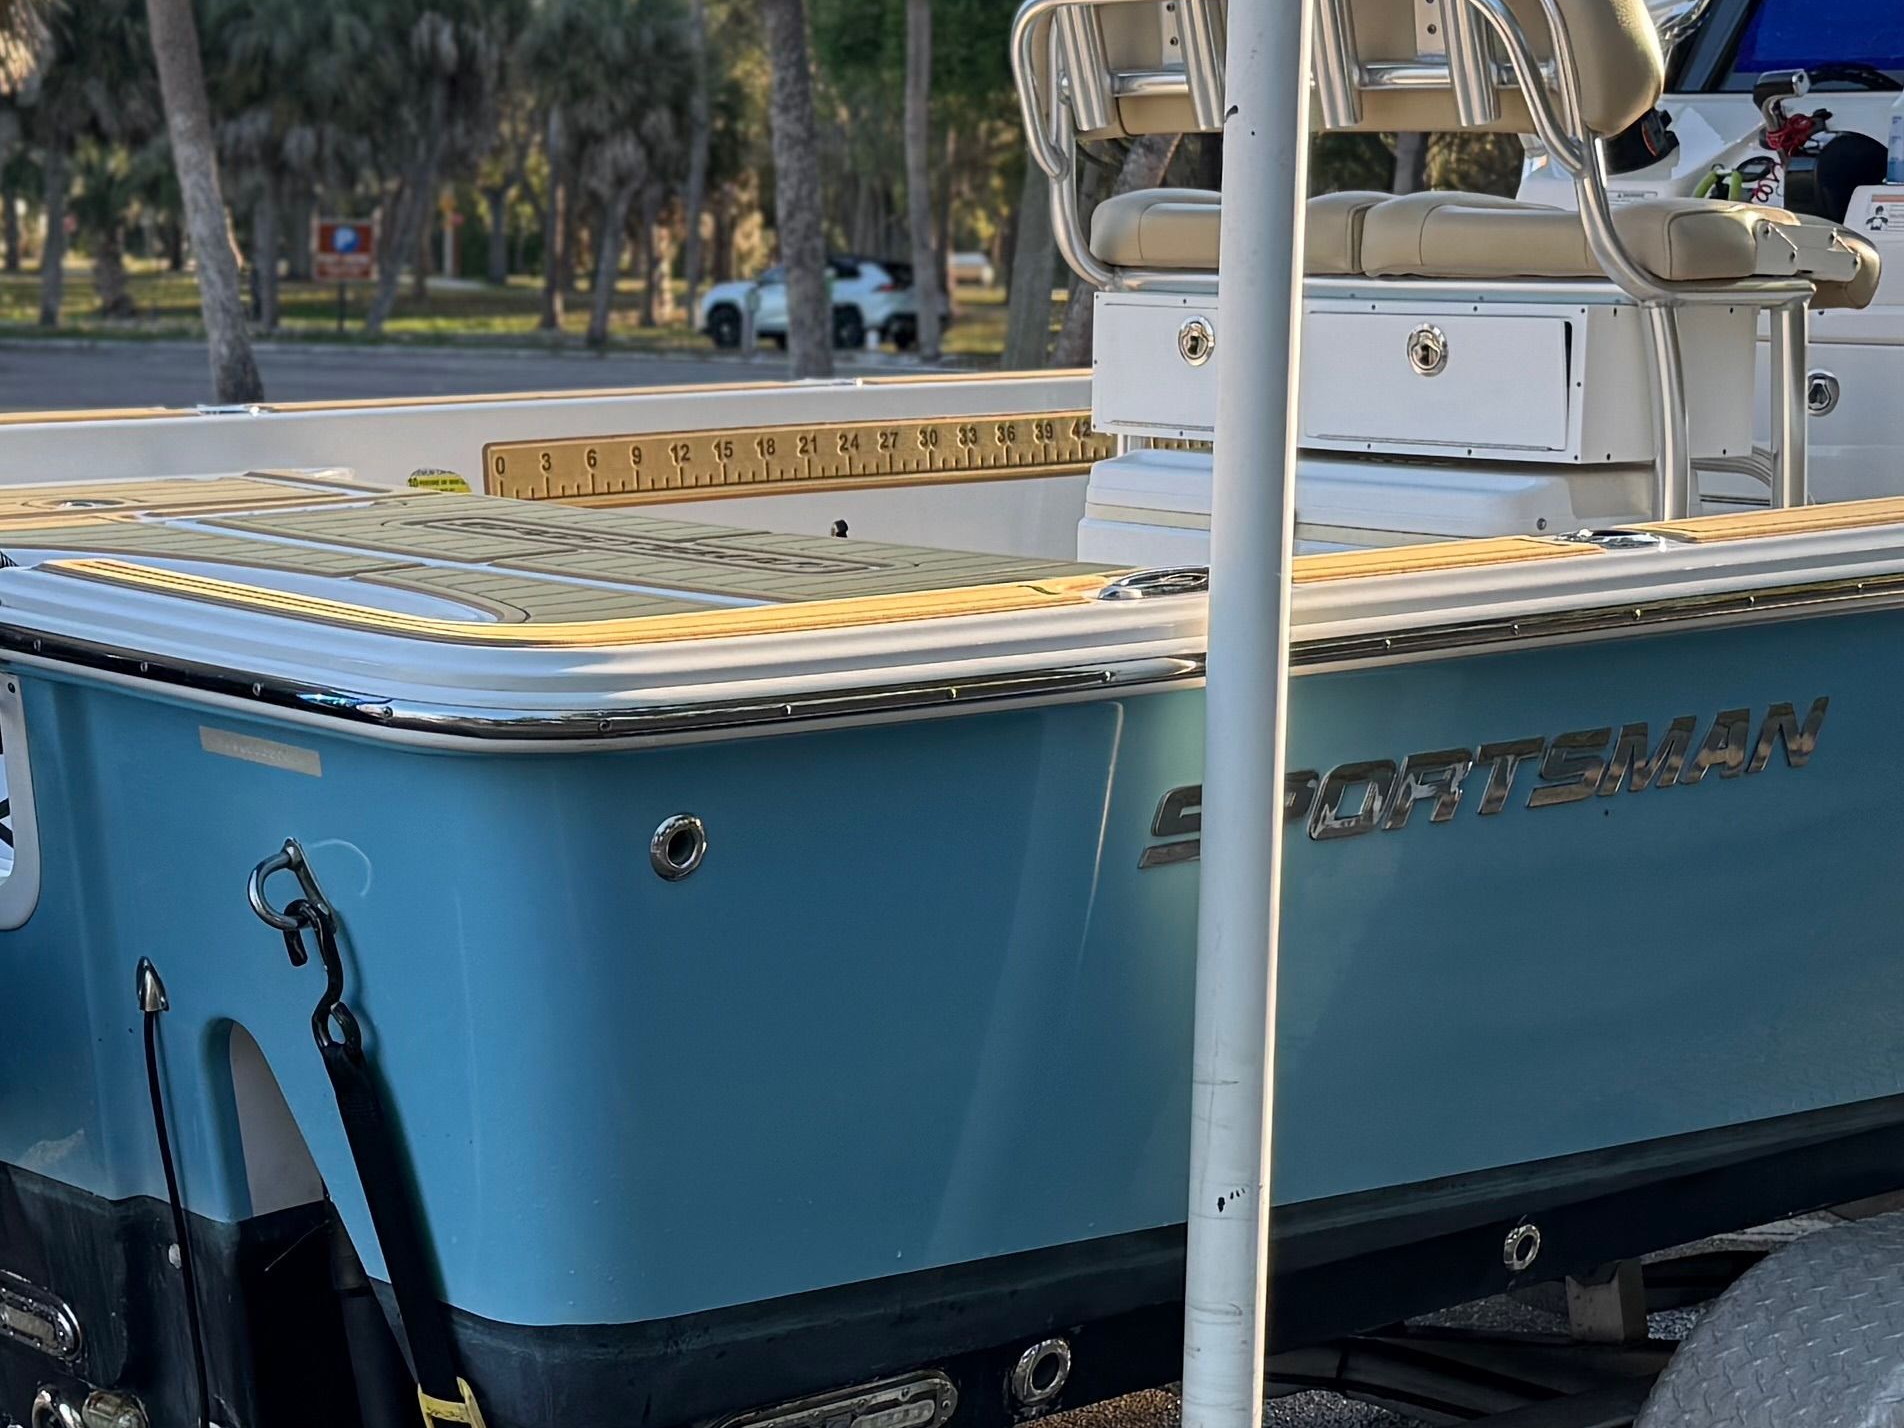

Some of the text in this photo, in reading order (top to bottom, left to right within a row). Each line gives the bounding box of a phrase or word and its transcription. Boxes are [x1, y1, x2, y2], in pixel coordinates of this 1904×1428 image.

[494, 454, 507, 475] 0
[541, 452, 552, 471] 3
[586, 448, 597, 467] 6
[631, 445, 643, 464] 9
[672, 443, 691, 462] 12
[714, 439, 734, 459] 15
[757, 436, 776, 455] 18
[798, 434, 817, 453] 21
[838, 433, 860, 451] 24
[879, 430, 899, 449] 27
[918, 429, 939, 446] 30
[958, 426, 978, 444] 33
[997, 423, 1016, 442] 36
[1034, 421, 1054, 439] 39
